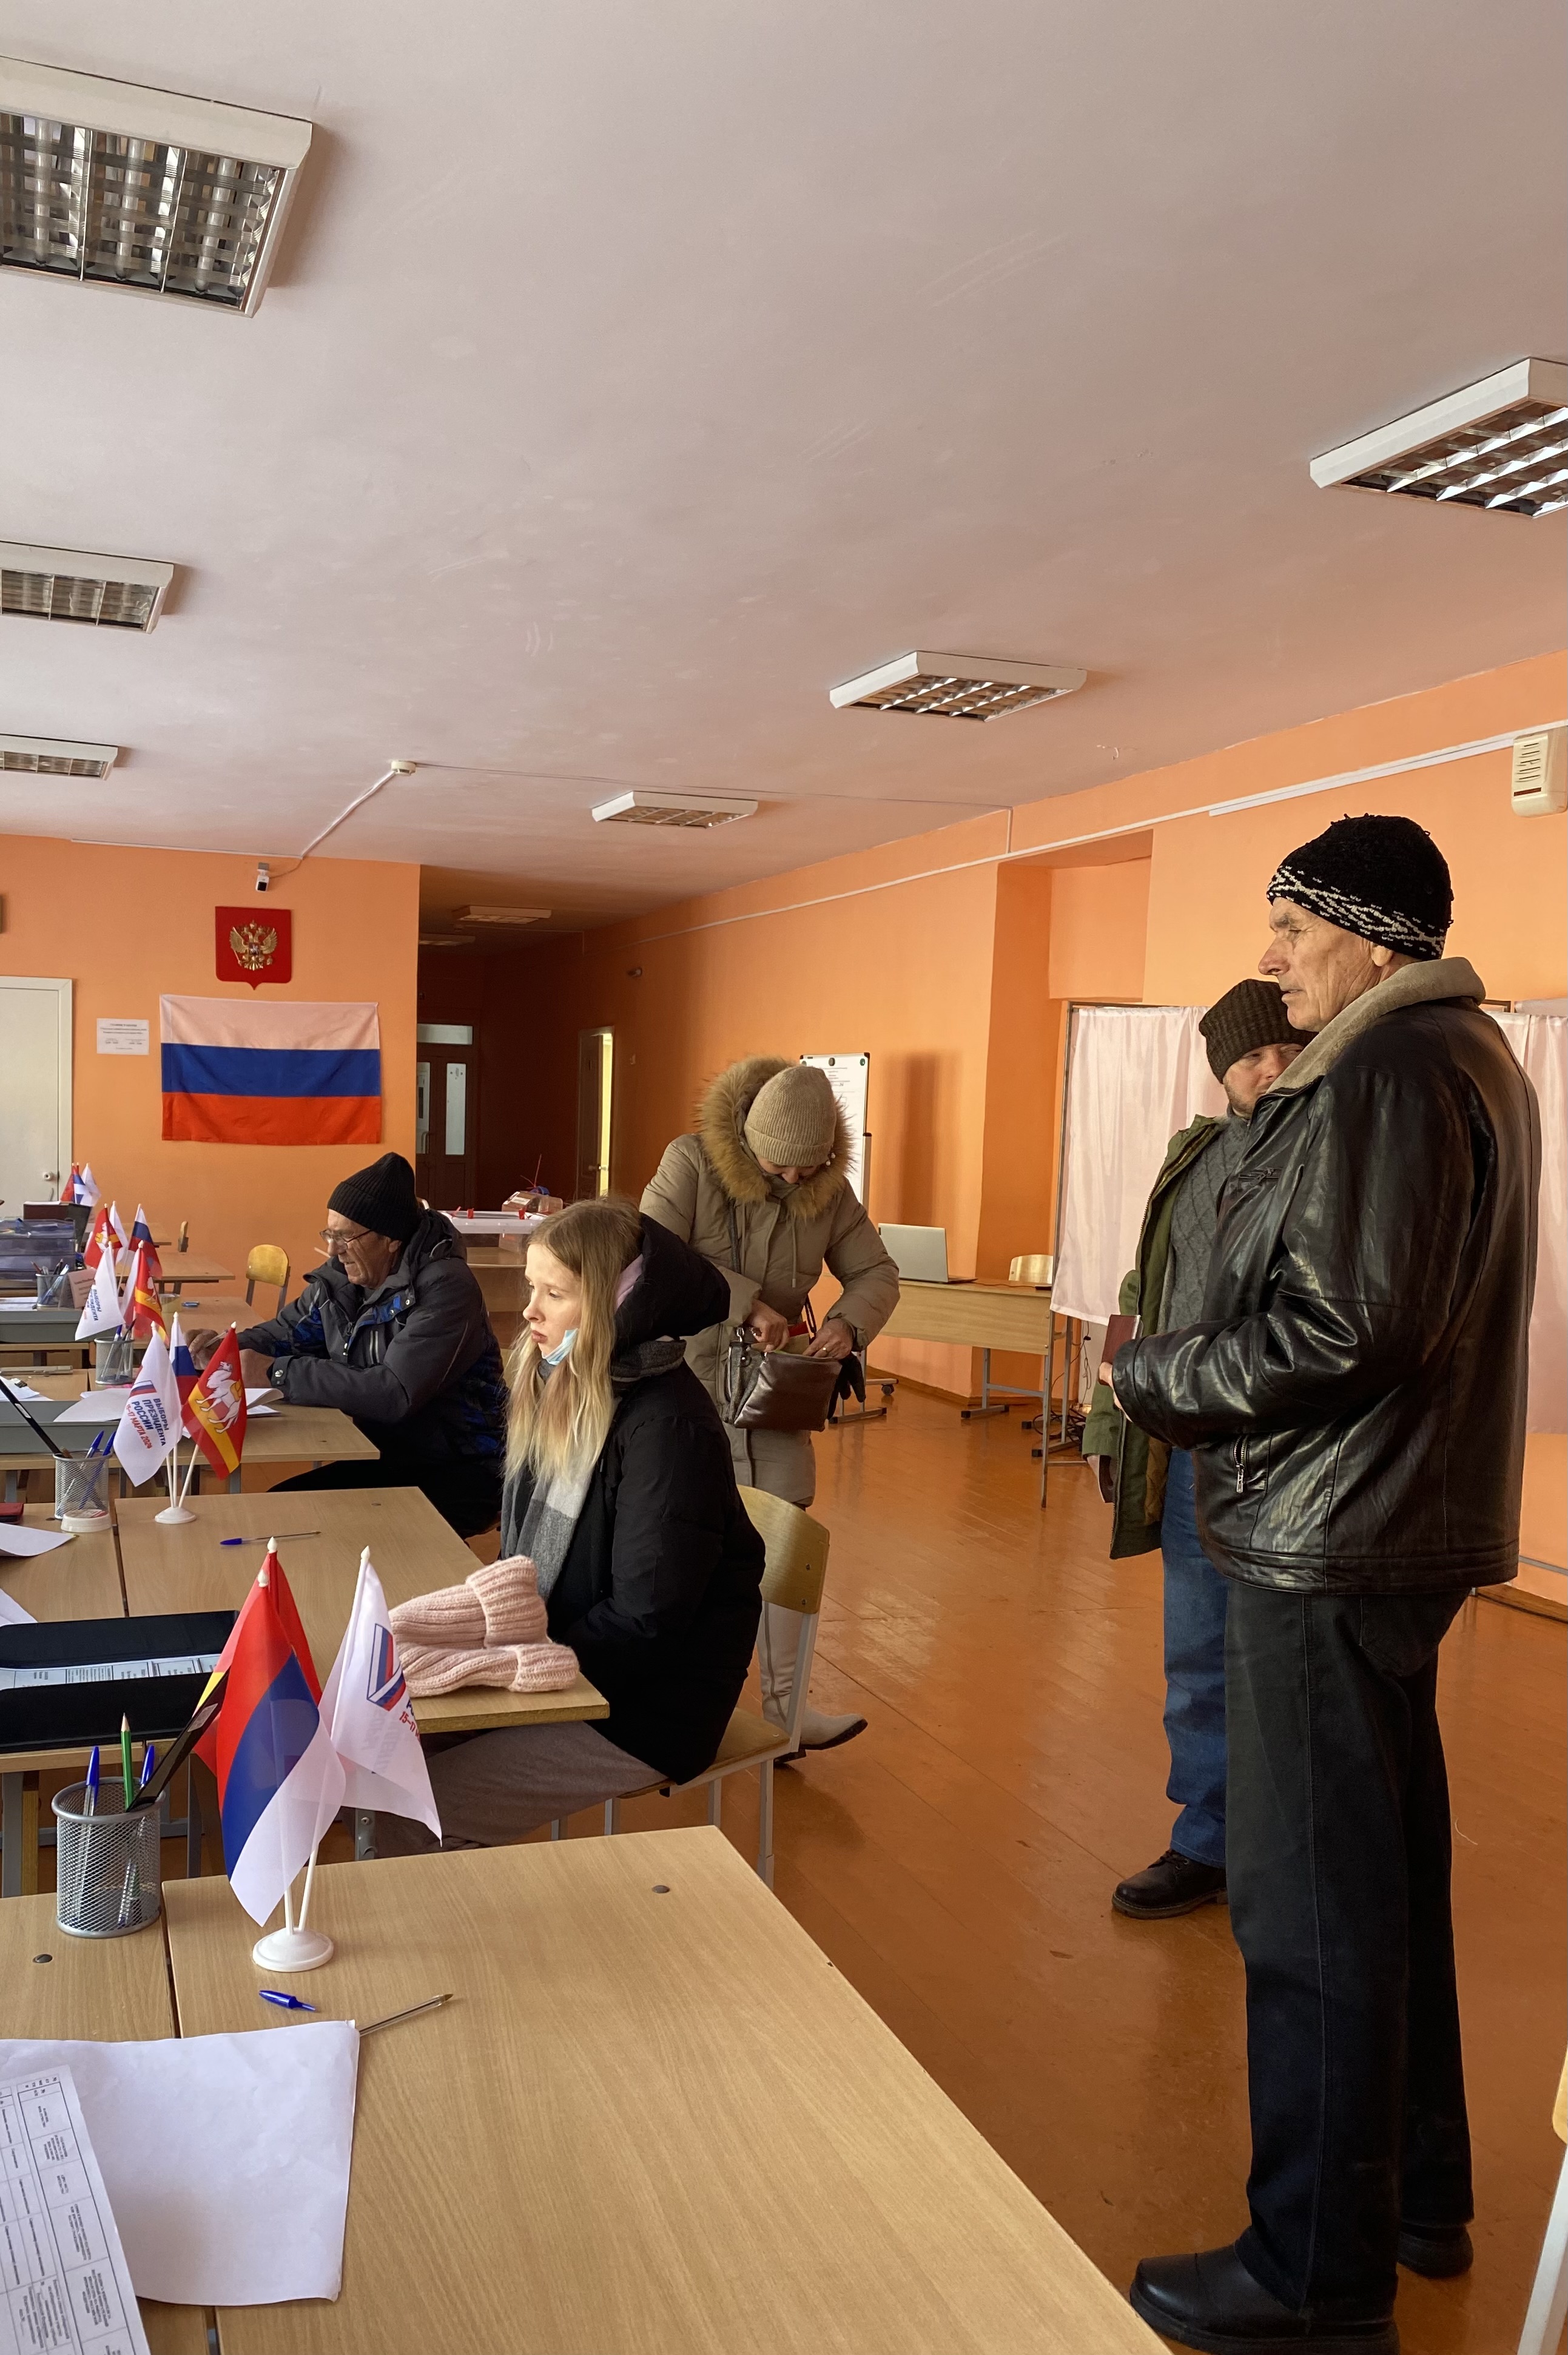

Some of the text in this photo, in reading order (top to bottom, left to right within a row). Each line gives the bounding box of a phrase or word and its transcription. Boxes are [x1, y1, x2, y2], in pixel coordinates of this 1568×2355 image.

[93, 1289, 102, 1312] ВЫБОРЫ
[130, 1417, 146, 1435] МАРТА
[132, 1401, 154, 1430] РОССИИ
[142, 1399, 166, 1446] ПРЕЗИДЕНТА
[153, 1398, 169, 1430] ВЫБОРЫ
